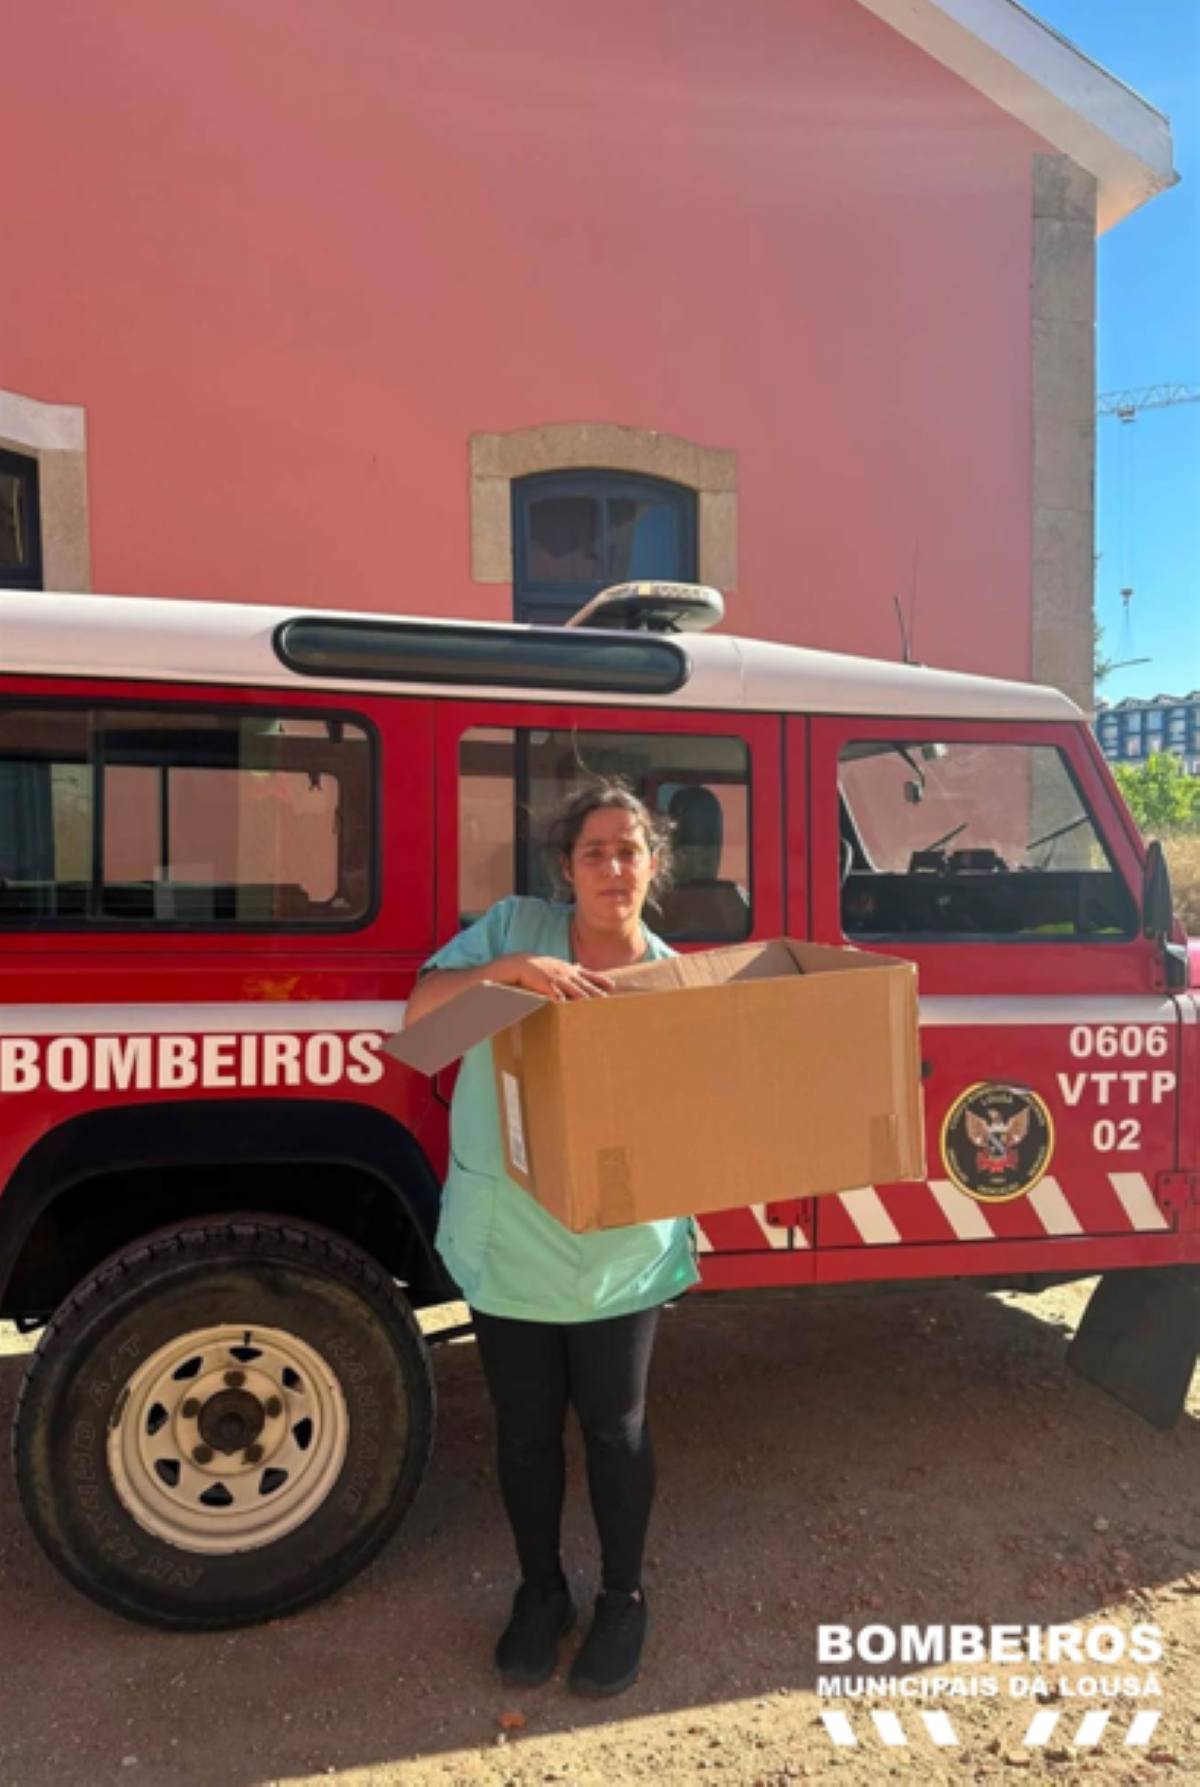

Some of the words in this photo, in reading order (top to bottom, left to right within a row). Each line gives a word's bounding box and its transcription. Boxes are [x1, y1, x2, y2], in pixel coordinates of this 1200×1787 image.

[1069, 1025, 1168, 1058] 0606
[0, 1032, 385, 1093] BOMBEIROS
[1056, 1070, 1176, 1106] VTTP
[1092, 1119, 1141, 1152] 02
